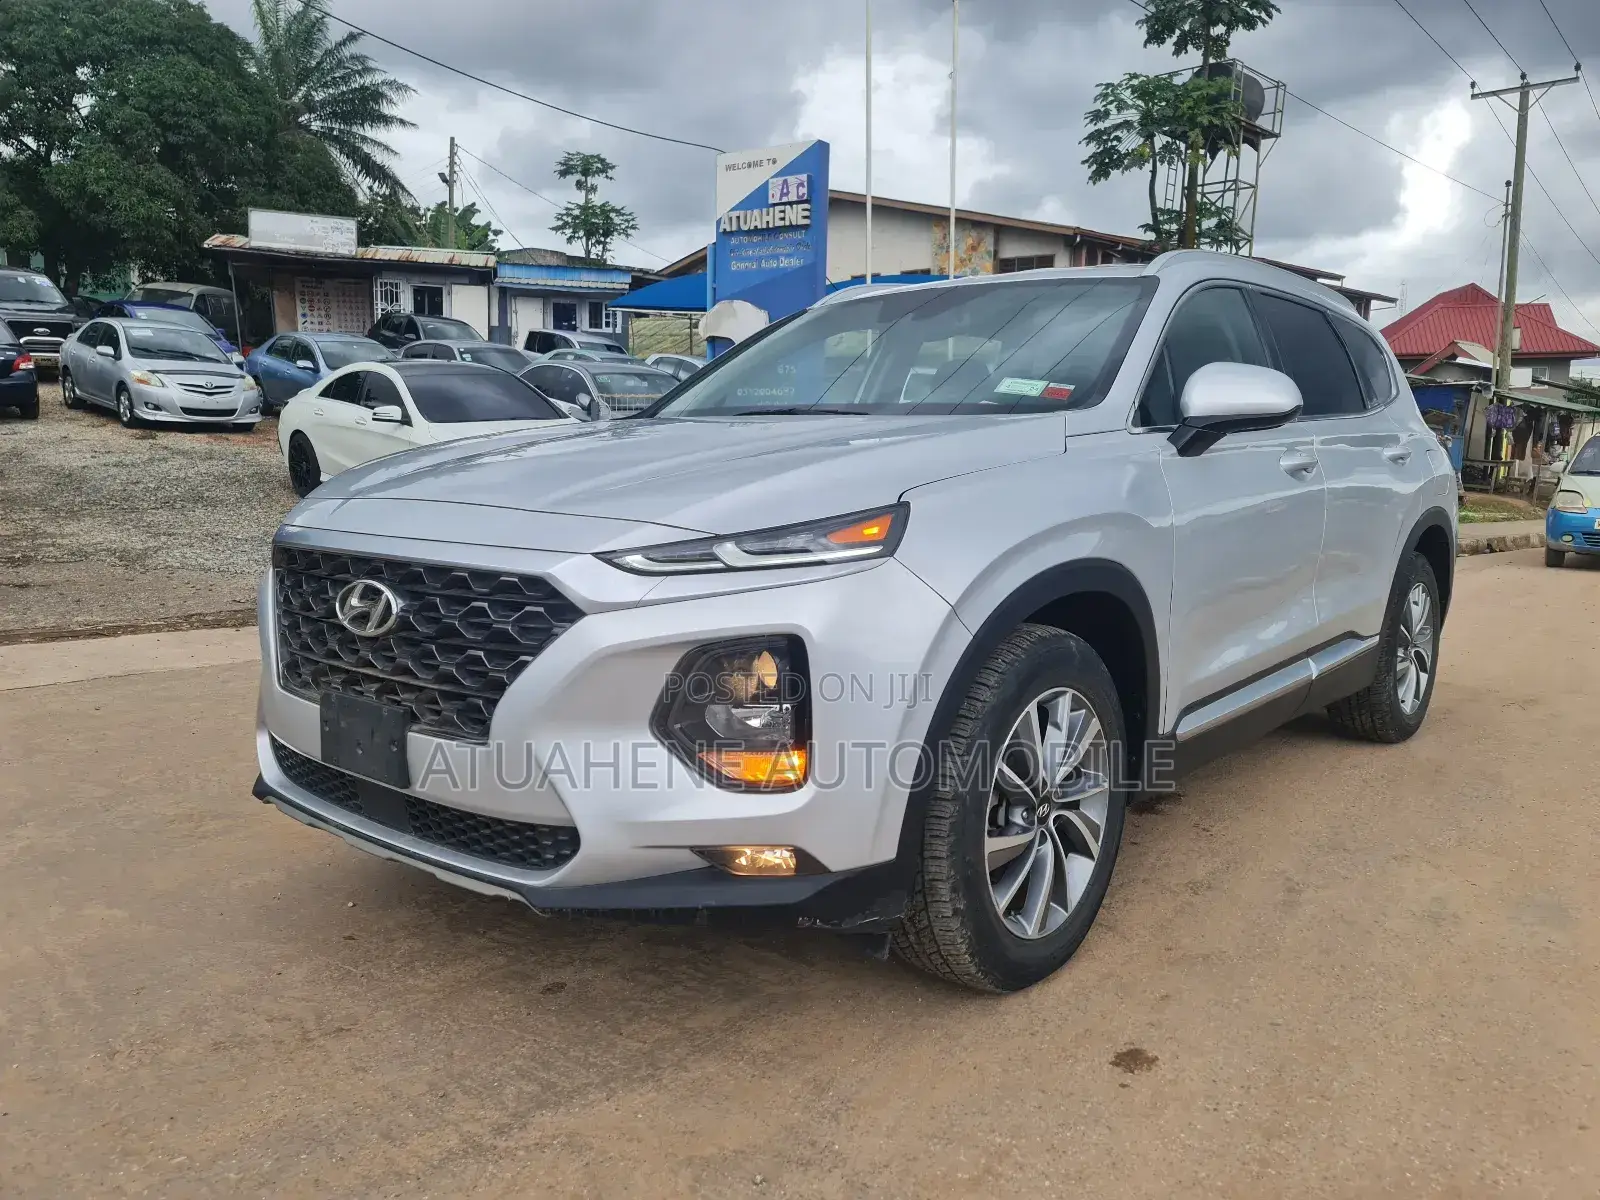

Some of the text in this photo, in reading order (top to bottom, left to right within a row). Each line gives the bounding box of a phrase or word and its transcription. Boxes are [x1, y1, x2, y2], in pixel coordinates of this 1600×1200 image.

[725, 157, 778, 172] WELCOME TO
[719, 204, 811, 232] ATUAHENE
[731, 256, 804, 271] General Auto Dealer
